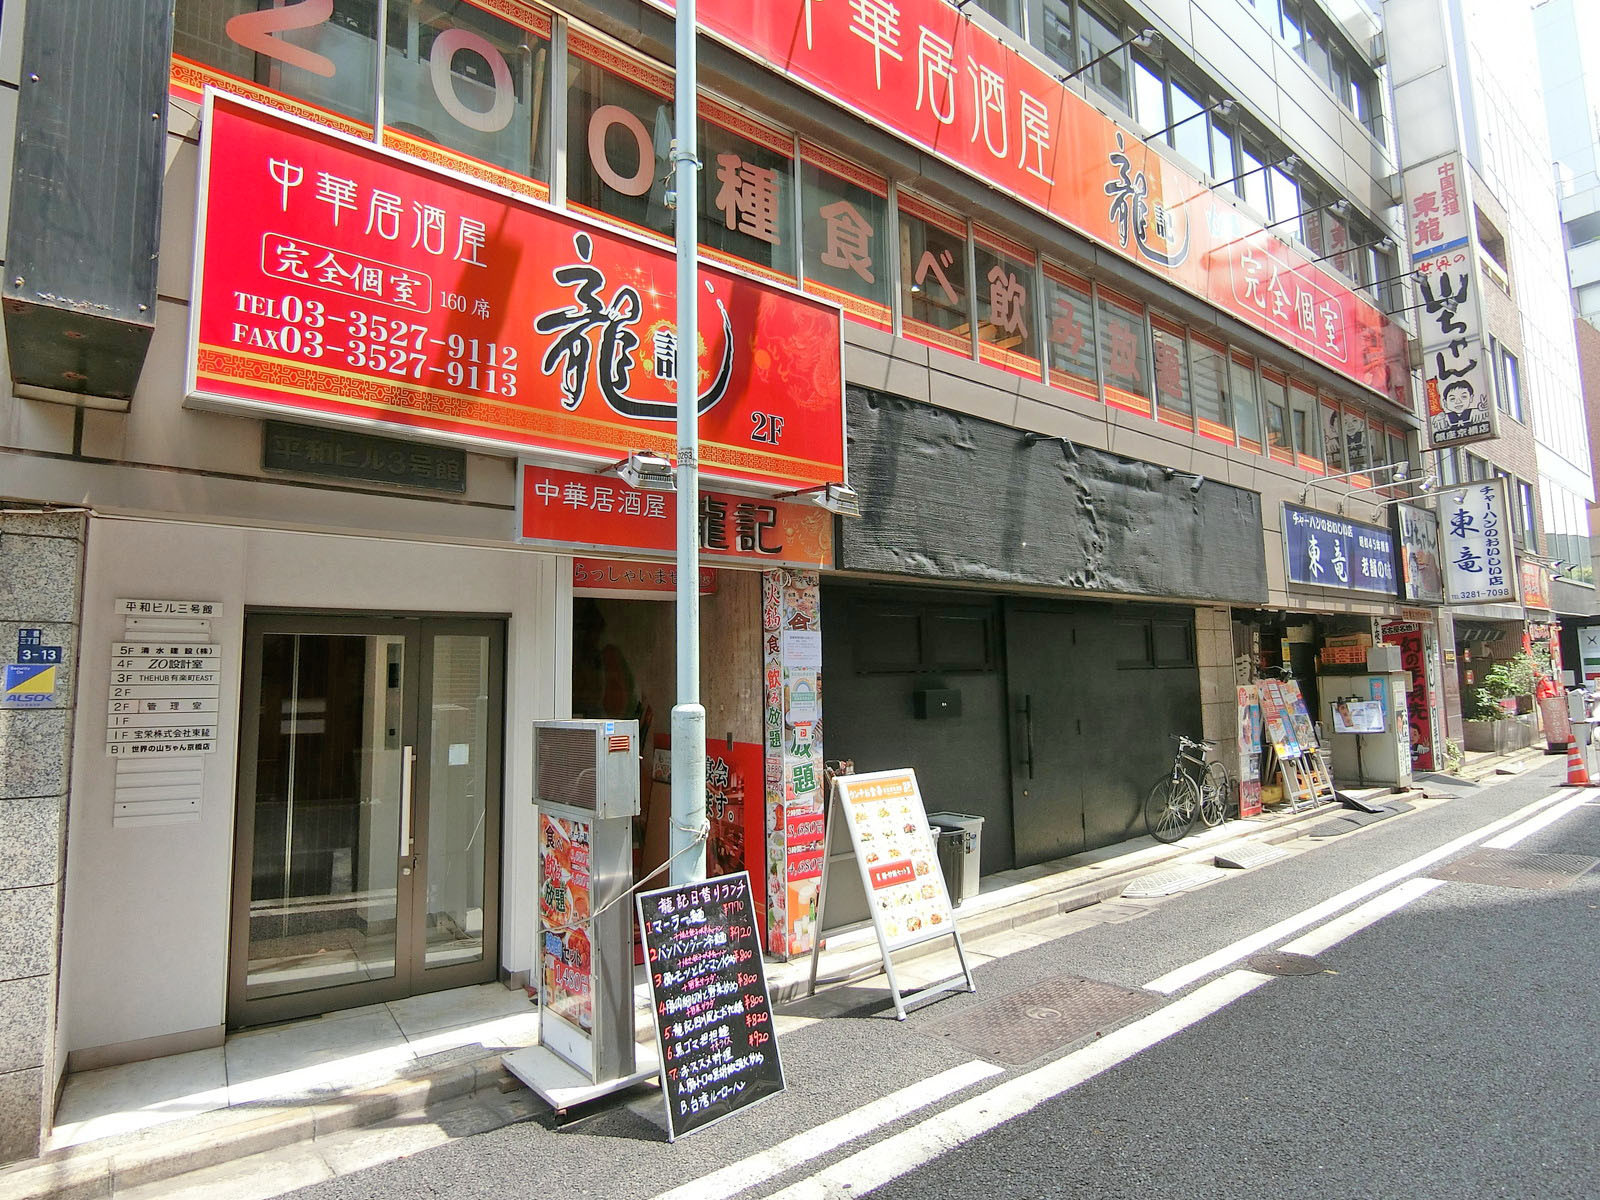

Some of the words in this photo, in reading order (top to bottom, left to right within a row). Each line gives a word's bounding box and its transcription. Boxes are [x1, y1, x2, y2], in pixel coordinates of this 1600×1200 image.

[268, 157, 488, 268] 中華居酒屋
[275, 242, 422, 306] 完全個室
[440, 291, 467, 312] 160
[472, 298, 490, 320] 席
[1241, 249, 1340, 351] 完全個室
[751, 411, 784, 445] 2F
[534, 478, 668, 520] 中華居酒屋
[1450, 508, 1482, 573] 東竜
[1480, 486, 1503, 586] チャーハンのおいしい店
[1308, 534, 1348, 582] 東竜
[1461, 588, 1509, 599] 3281-7098
[126, 602, 213, 614] 平和ビル三号館
[22, 649, 57, 660] 3-13
[120, 647, 134, 655] 5F
[117, 660, 133, 668] 4F
[117, 674, 132, 682] 3F
[115, 688, 131, 696] 2F
[114, 703, 129, 711] 2F
[111, 745, 125, 753] B1
